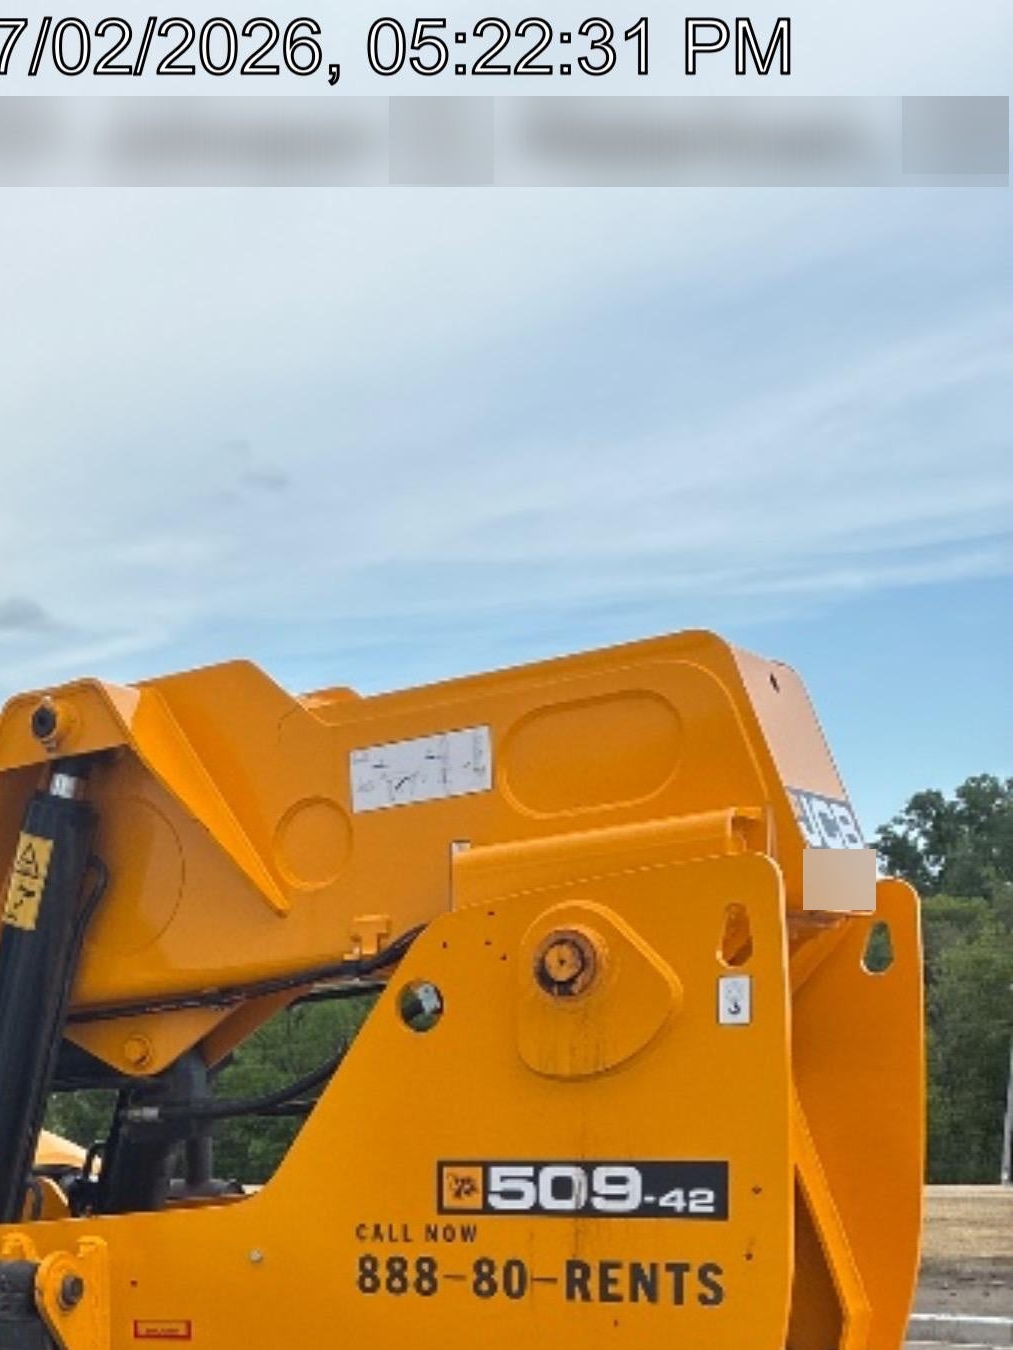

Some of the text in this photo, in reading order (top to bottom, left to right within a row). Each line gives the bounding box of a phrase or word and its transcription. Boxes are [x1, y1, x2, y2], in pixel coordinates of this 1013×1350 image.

[797, 793, 865, 849] JCB
[488, 1165, 716, 1213] 509-42
[355, 1223, 478, 1243] CALL NOW
[357, 1254, 725, 1307] 888-80-RENTS
